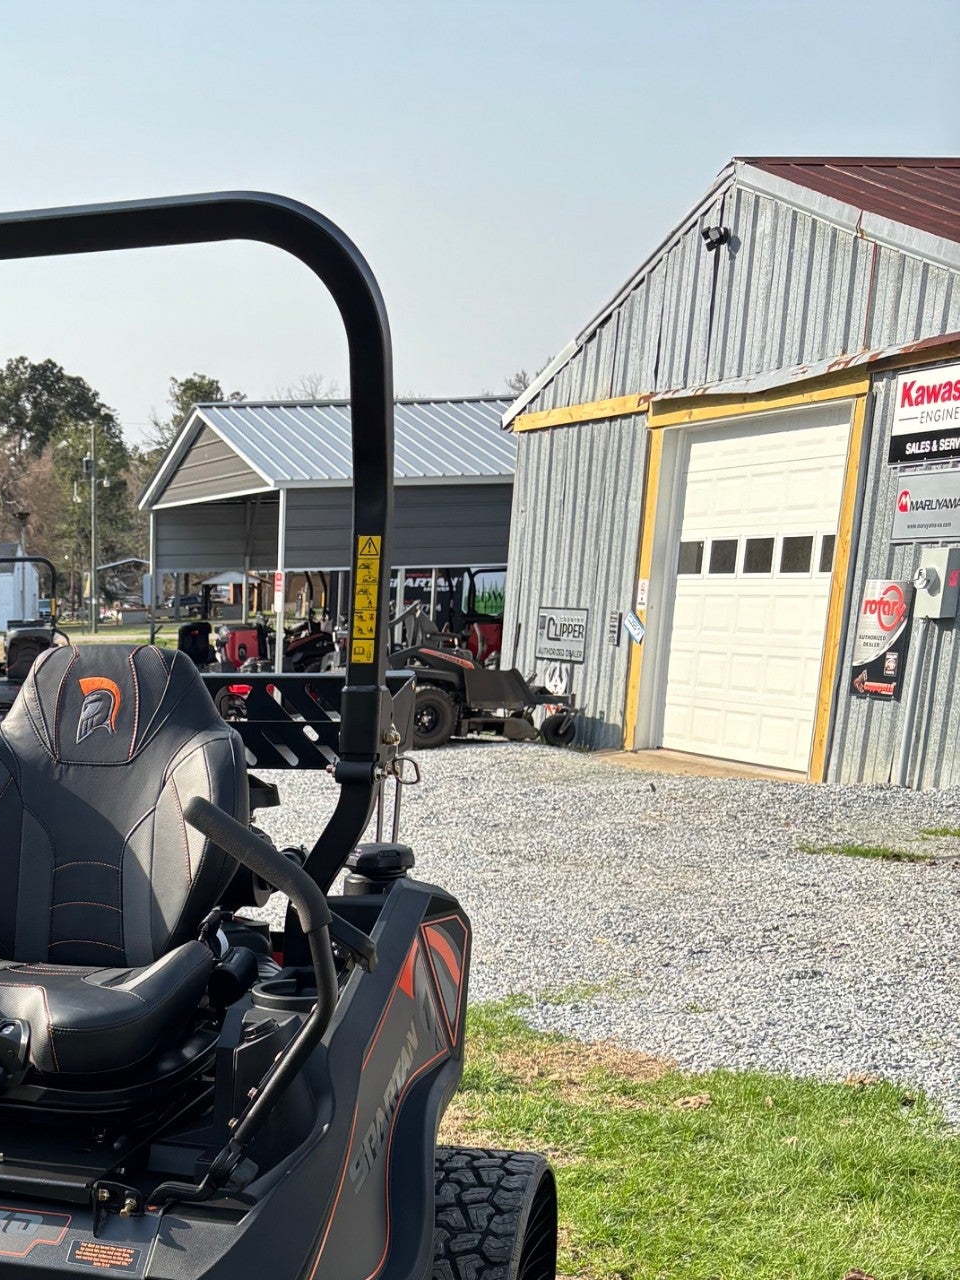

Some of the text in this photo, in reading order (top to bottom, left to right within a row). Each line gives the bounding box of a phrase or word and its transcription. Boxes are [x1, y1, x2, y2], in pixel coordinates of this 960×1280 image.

[900, 380, 960, 408] Kawas
[905, 440, 931, 455] SALES
[931, 439, 938, 452] &
[547, 617, 585, 641] CLIPPER
[538, 647, 582, 658] AUTHORIZED DEALER
[349, 1017, 419, 1196] SPARTAN
